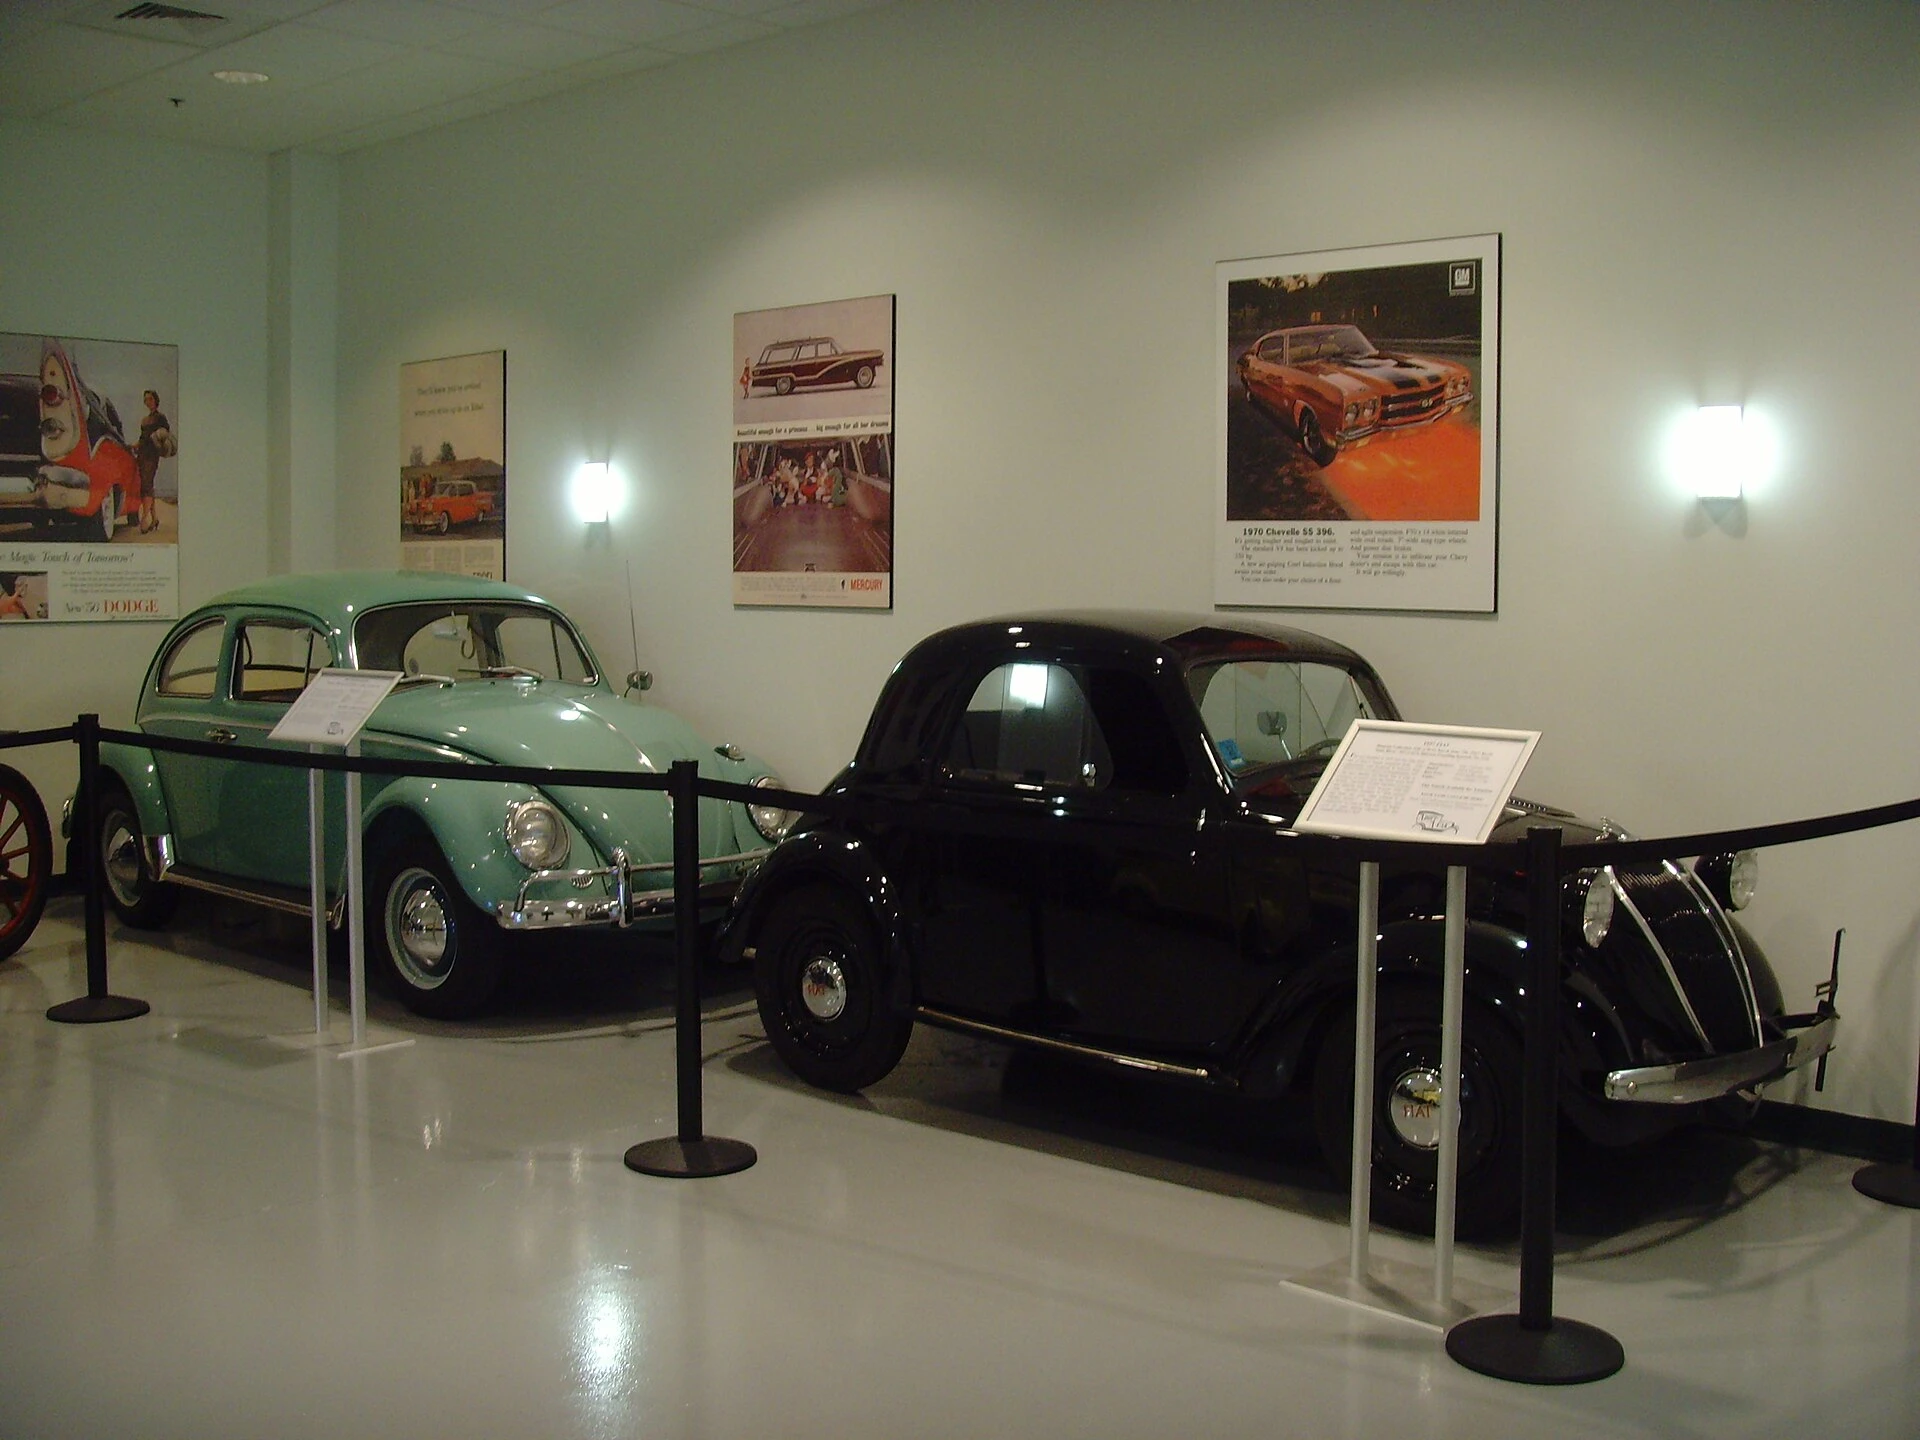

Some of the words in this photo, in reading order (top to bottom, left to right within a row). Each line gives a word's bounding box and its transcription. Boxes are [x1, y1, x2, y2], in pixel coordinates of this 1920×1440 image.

[1454, 267, 1470, 286] GM
[1243, 527, 1264, 536] 1970
[1266, 527, 1300, 536] Chevelle
[1302, 527, 1314, 536] SS
[1316, 527, 1335, 536] 396.
[73, 551, 83, 563] of
[850, 579, 883, 591] MERCURY
[103, 599, 160, 614] DODGE
